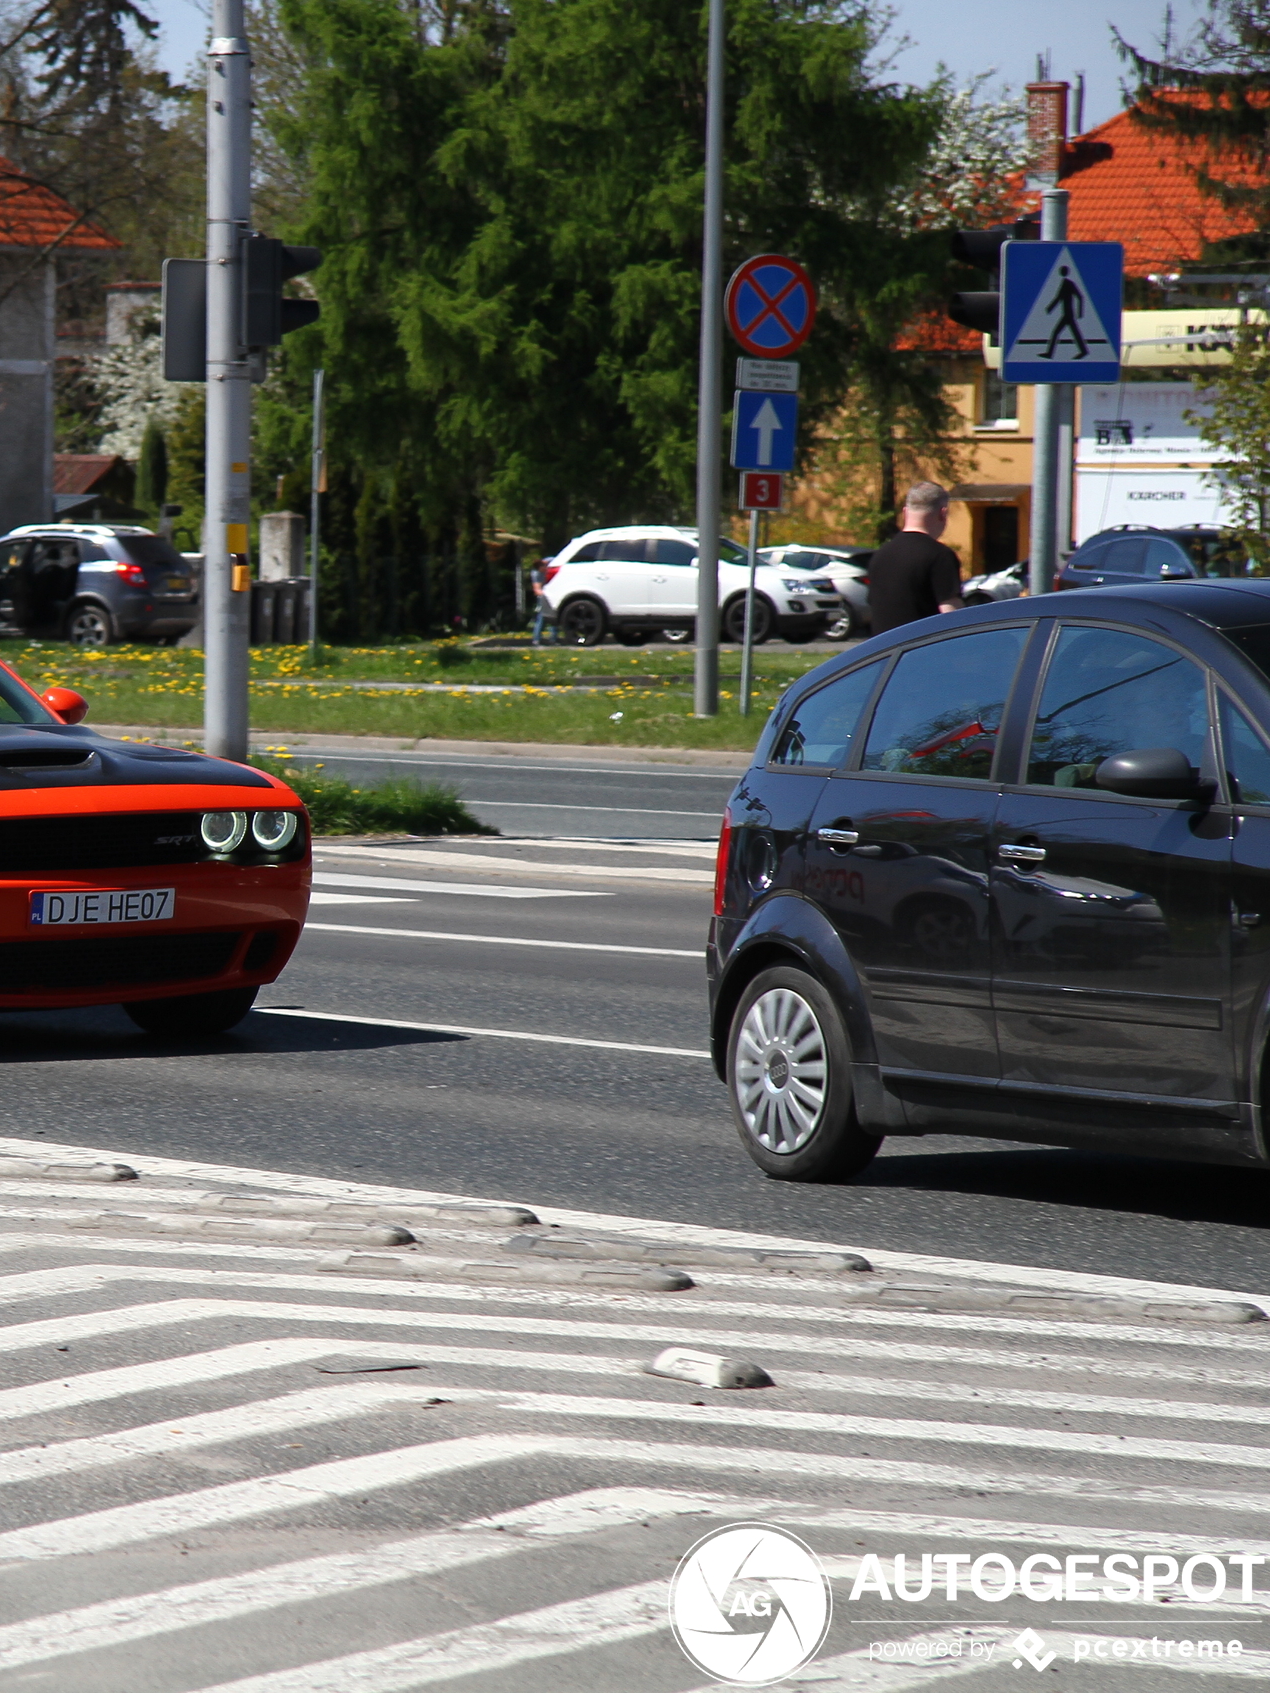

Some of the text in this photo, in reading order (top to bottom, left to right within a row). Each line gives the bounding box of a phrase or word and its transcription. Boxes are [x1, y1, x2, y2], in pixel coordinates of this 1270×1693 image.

[755, 479, 770, 502] 3
[153, 834, 197, 846] SRT
[48, 891, 169, 923] DJE HE07
[31, 913, 41, 921] PL
